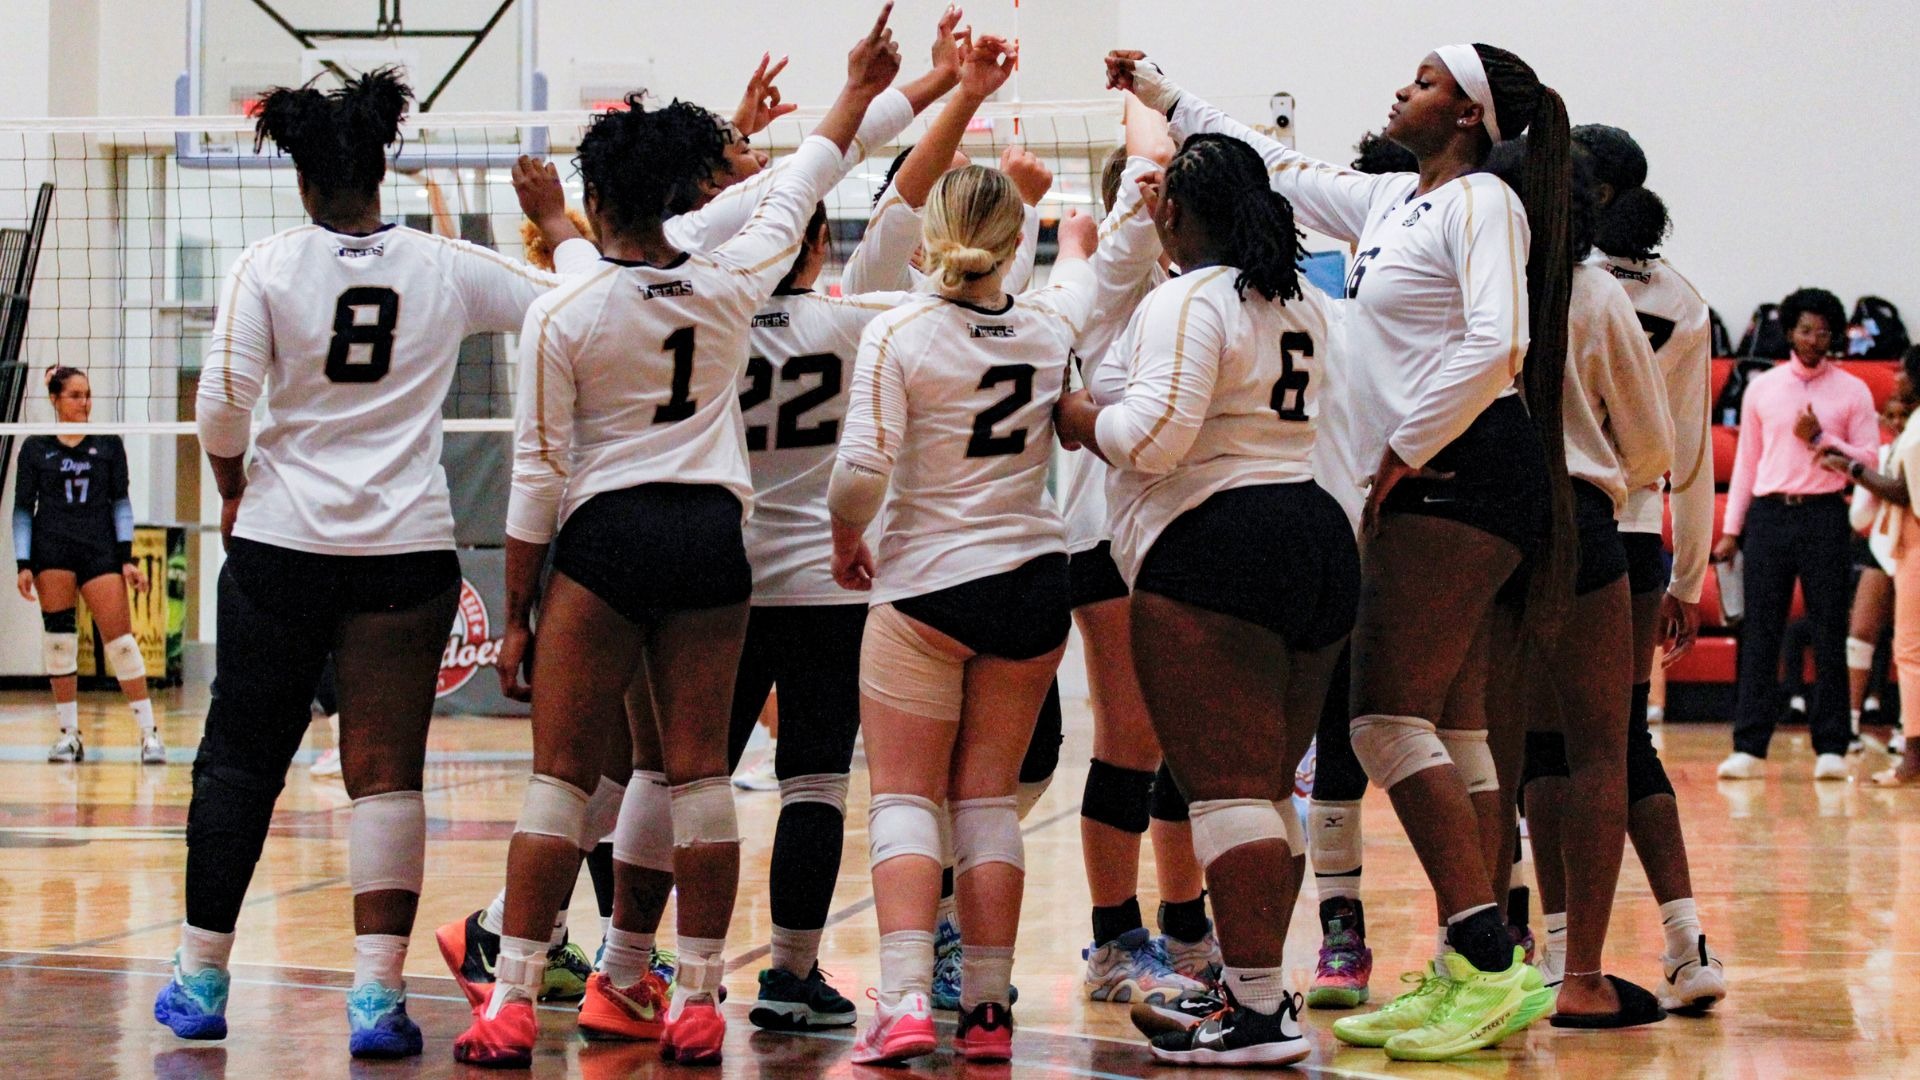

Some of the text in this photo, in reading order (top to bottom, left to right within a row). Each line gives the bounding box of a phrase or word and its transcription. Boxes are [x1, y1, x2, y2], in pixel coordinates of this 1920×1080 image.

[325, 286, 399, 382] 8
[638, 281, 693, 300] TIGERS
[751, 312, 790, 328] IGERS
[652, 326, 697, 424] 1
[738, 353, 842, 451] 22
[966, 364, 1036, 457] 2
[1270, 331, 1314, 421] 6
[65, 478, 89, 503] 17
